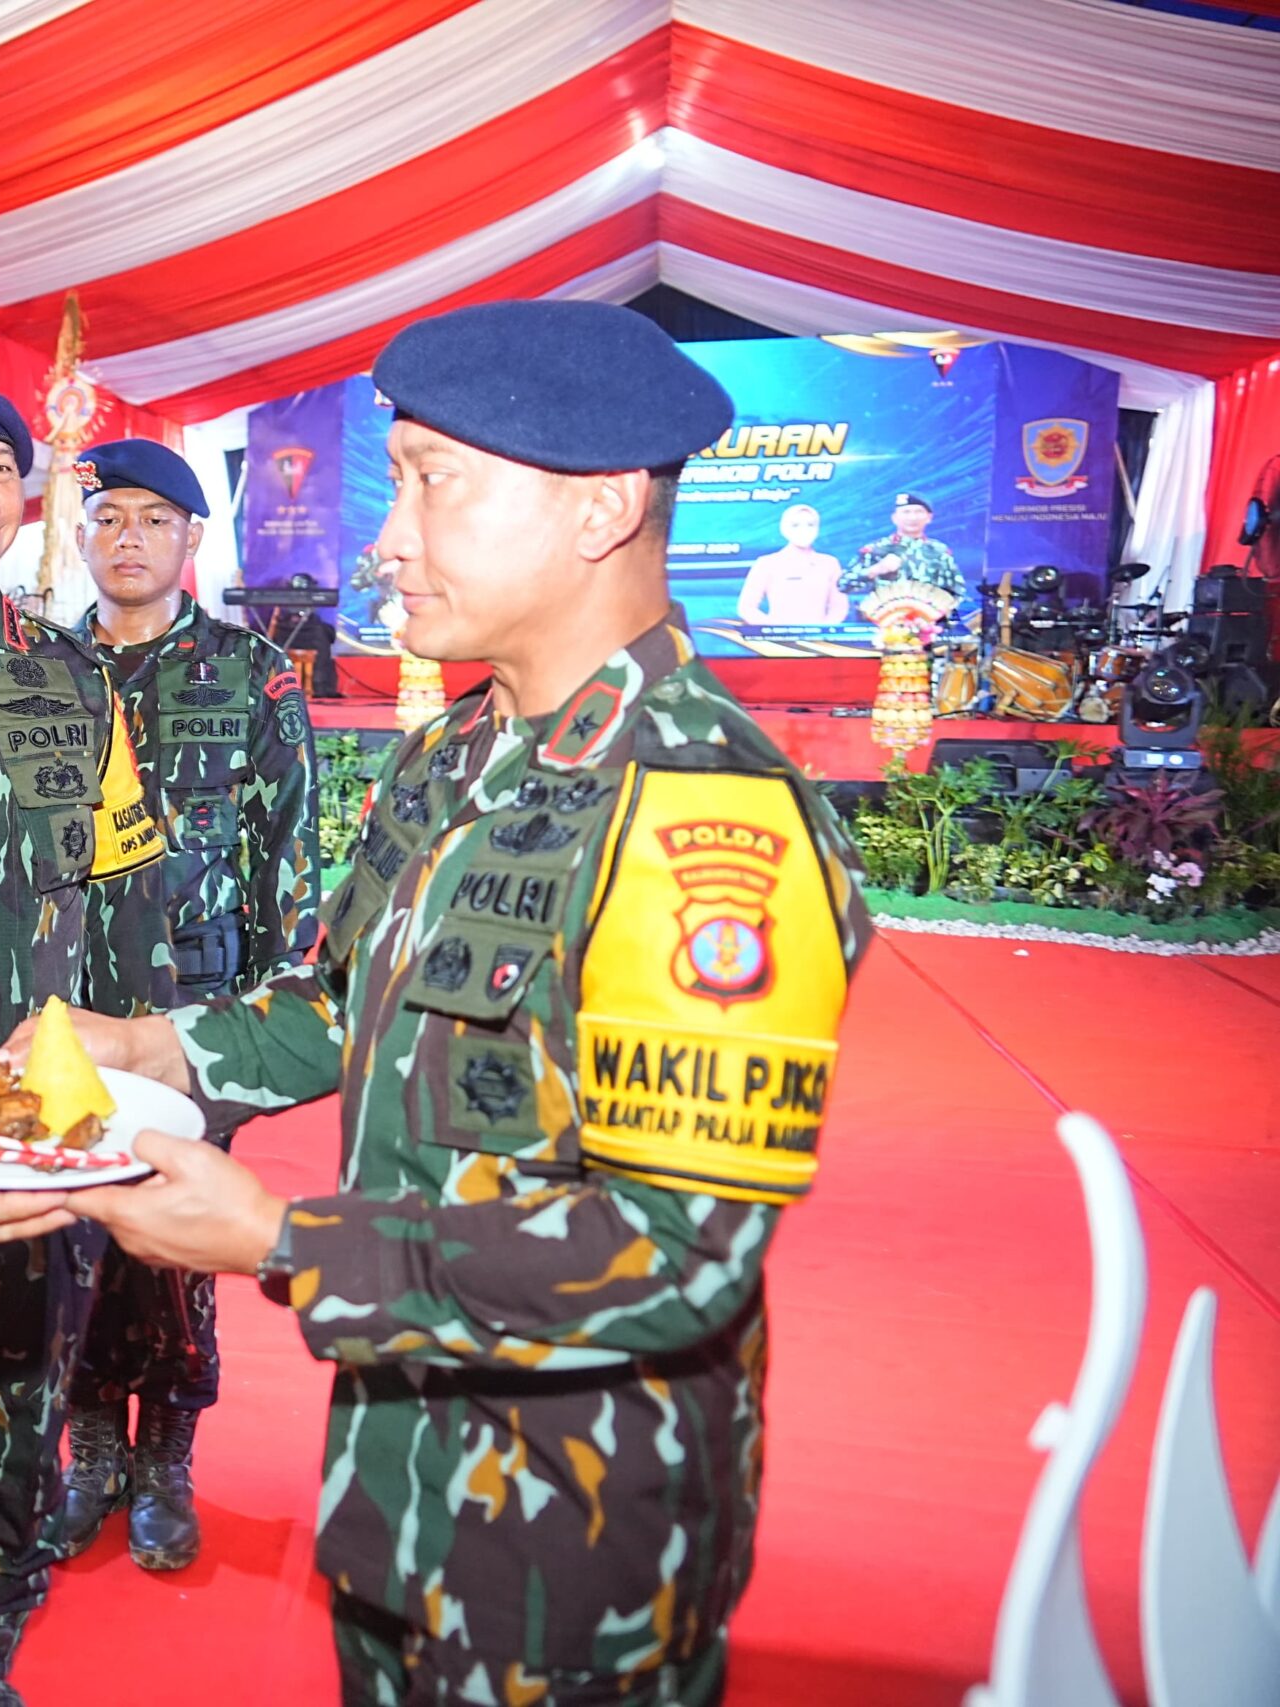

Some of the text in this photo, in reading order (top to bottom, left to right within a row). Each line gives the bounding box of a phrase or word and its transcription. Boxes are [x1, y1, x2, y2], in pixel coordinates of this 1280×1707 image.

[688, 422, 849, 459] URAN
[762, 462, 834, 482] POLRI
[8, 722, 88, 752] POLRI
[172, 718, 240, 737] POLRI
[121, 838, 137, 854] OPS
[670, 825, 775, 858] POLDA
[450, 871, 556, 925] POLRI
[593, 1036, 728, 1102] WAKIL
